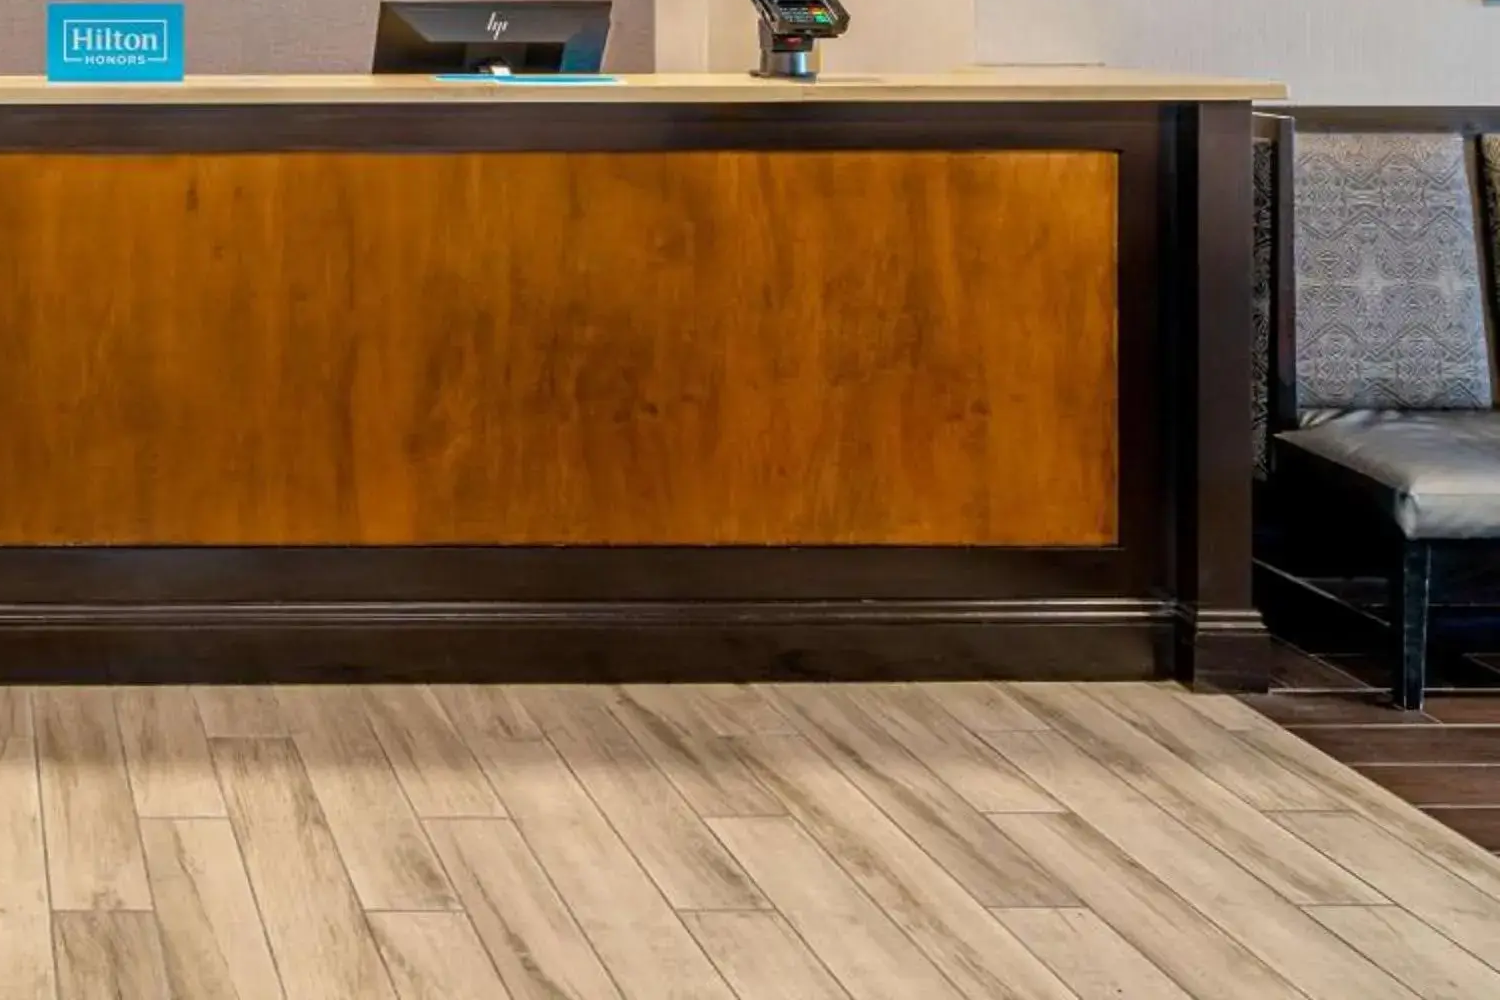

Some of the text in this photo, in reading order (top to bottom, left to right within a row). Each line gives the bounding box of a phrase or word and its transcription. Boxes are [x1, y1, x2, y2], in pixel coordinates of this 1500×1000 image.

[486, 12, 509, 40] hp
[72, 27, 158, 51] Hilton
[85, 55, 146, 65] HONORS
